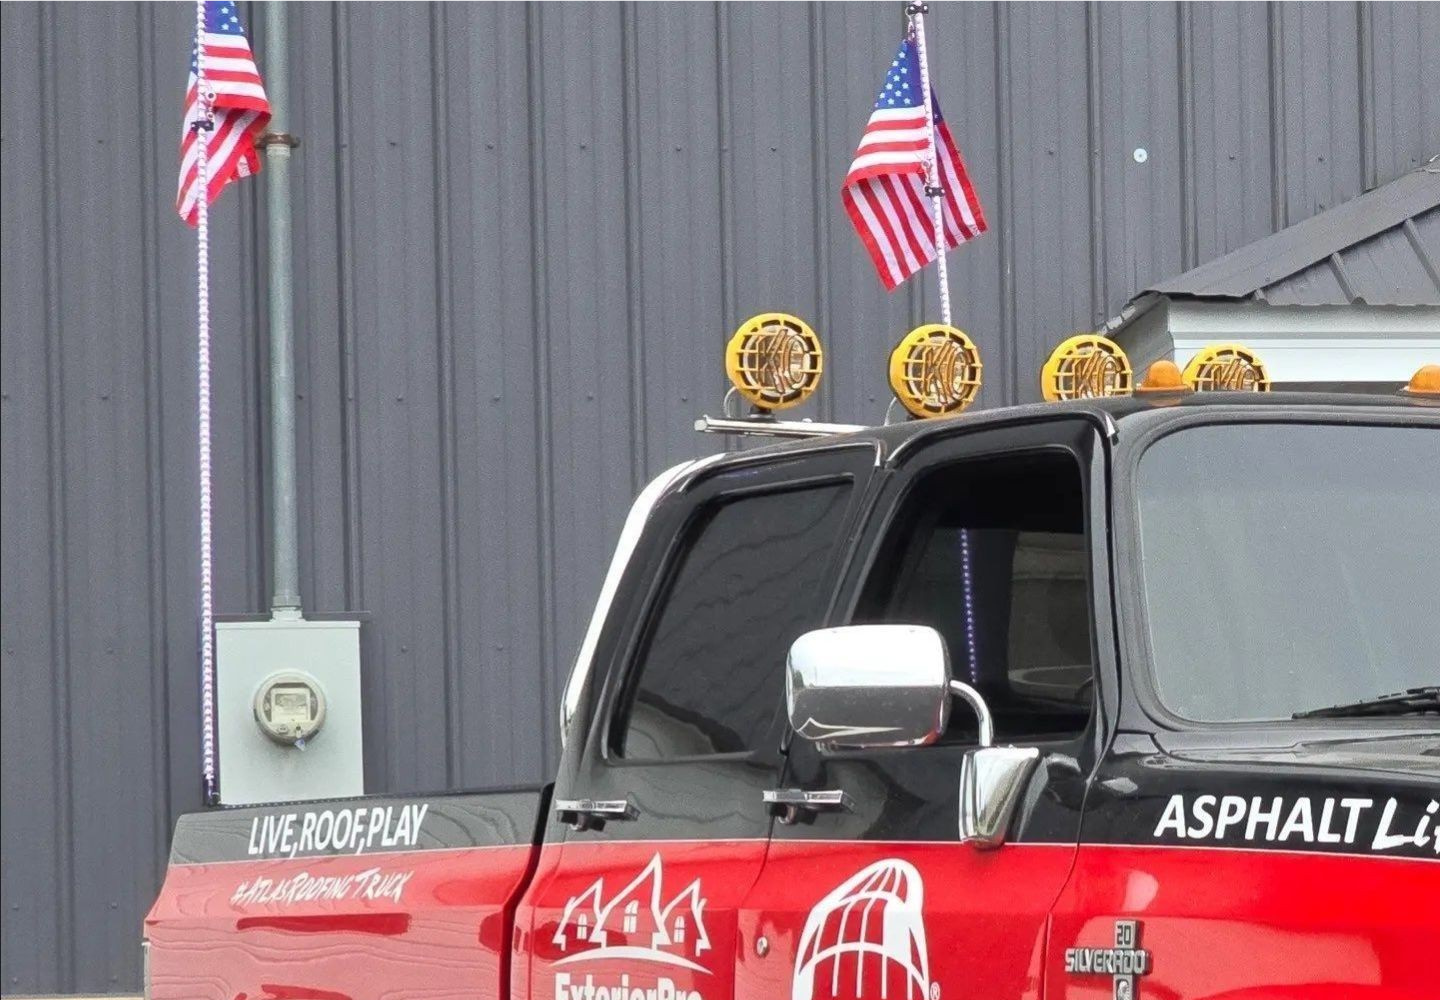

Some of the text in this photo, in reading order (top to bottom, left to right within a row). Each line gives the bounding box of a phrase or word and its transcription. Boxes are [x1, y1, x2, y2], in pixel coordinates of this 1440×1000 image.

[1153, 793, 1373, 844] ASPHALT
[1116, 925, 1132, 945] 20
[1064, 947, 1146, 974] SILVERADO
